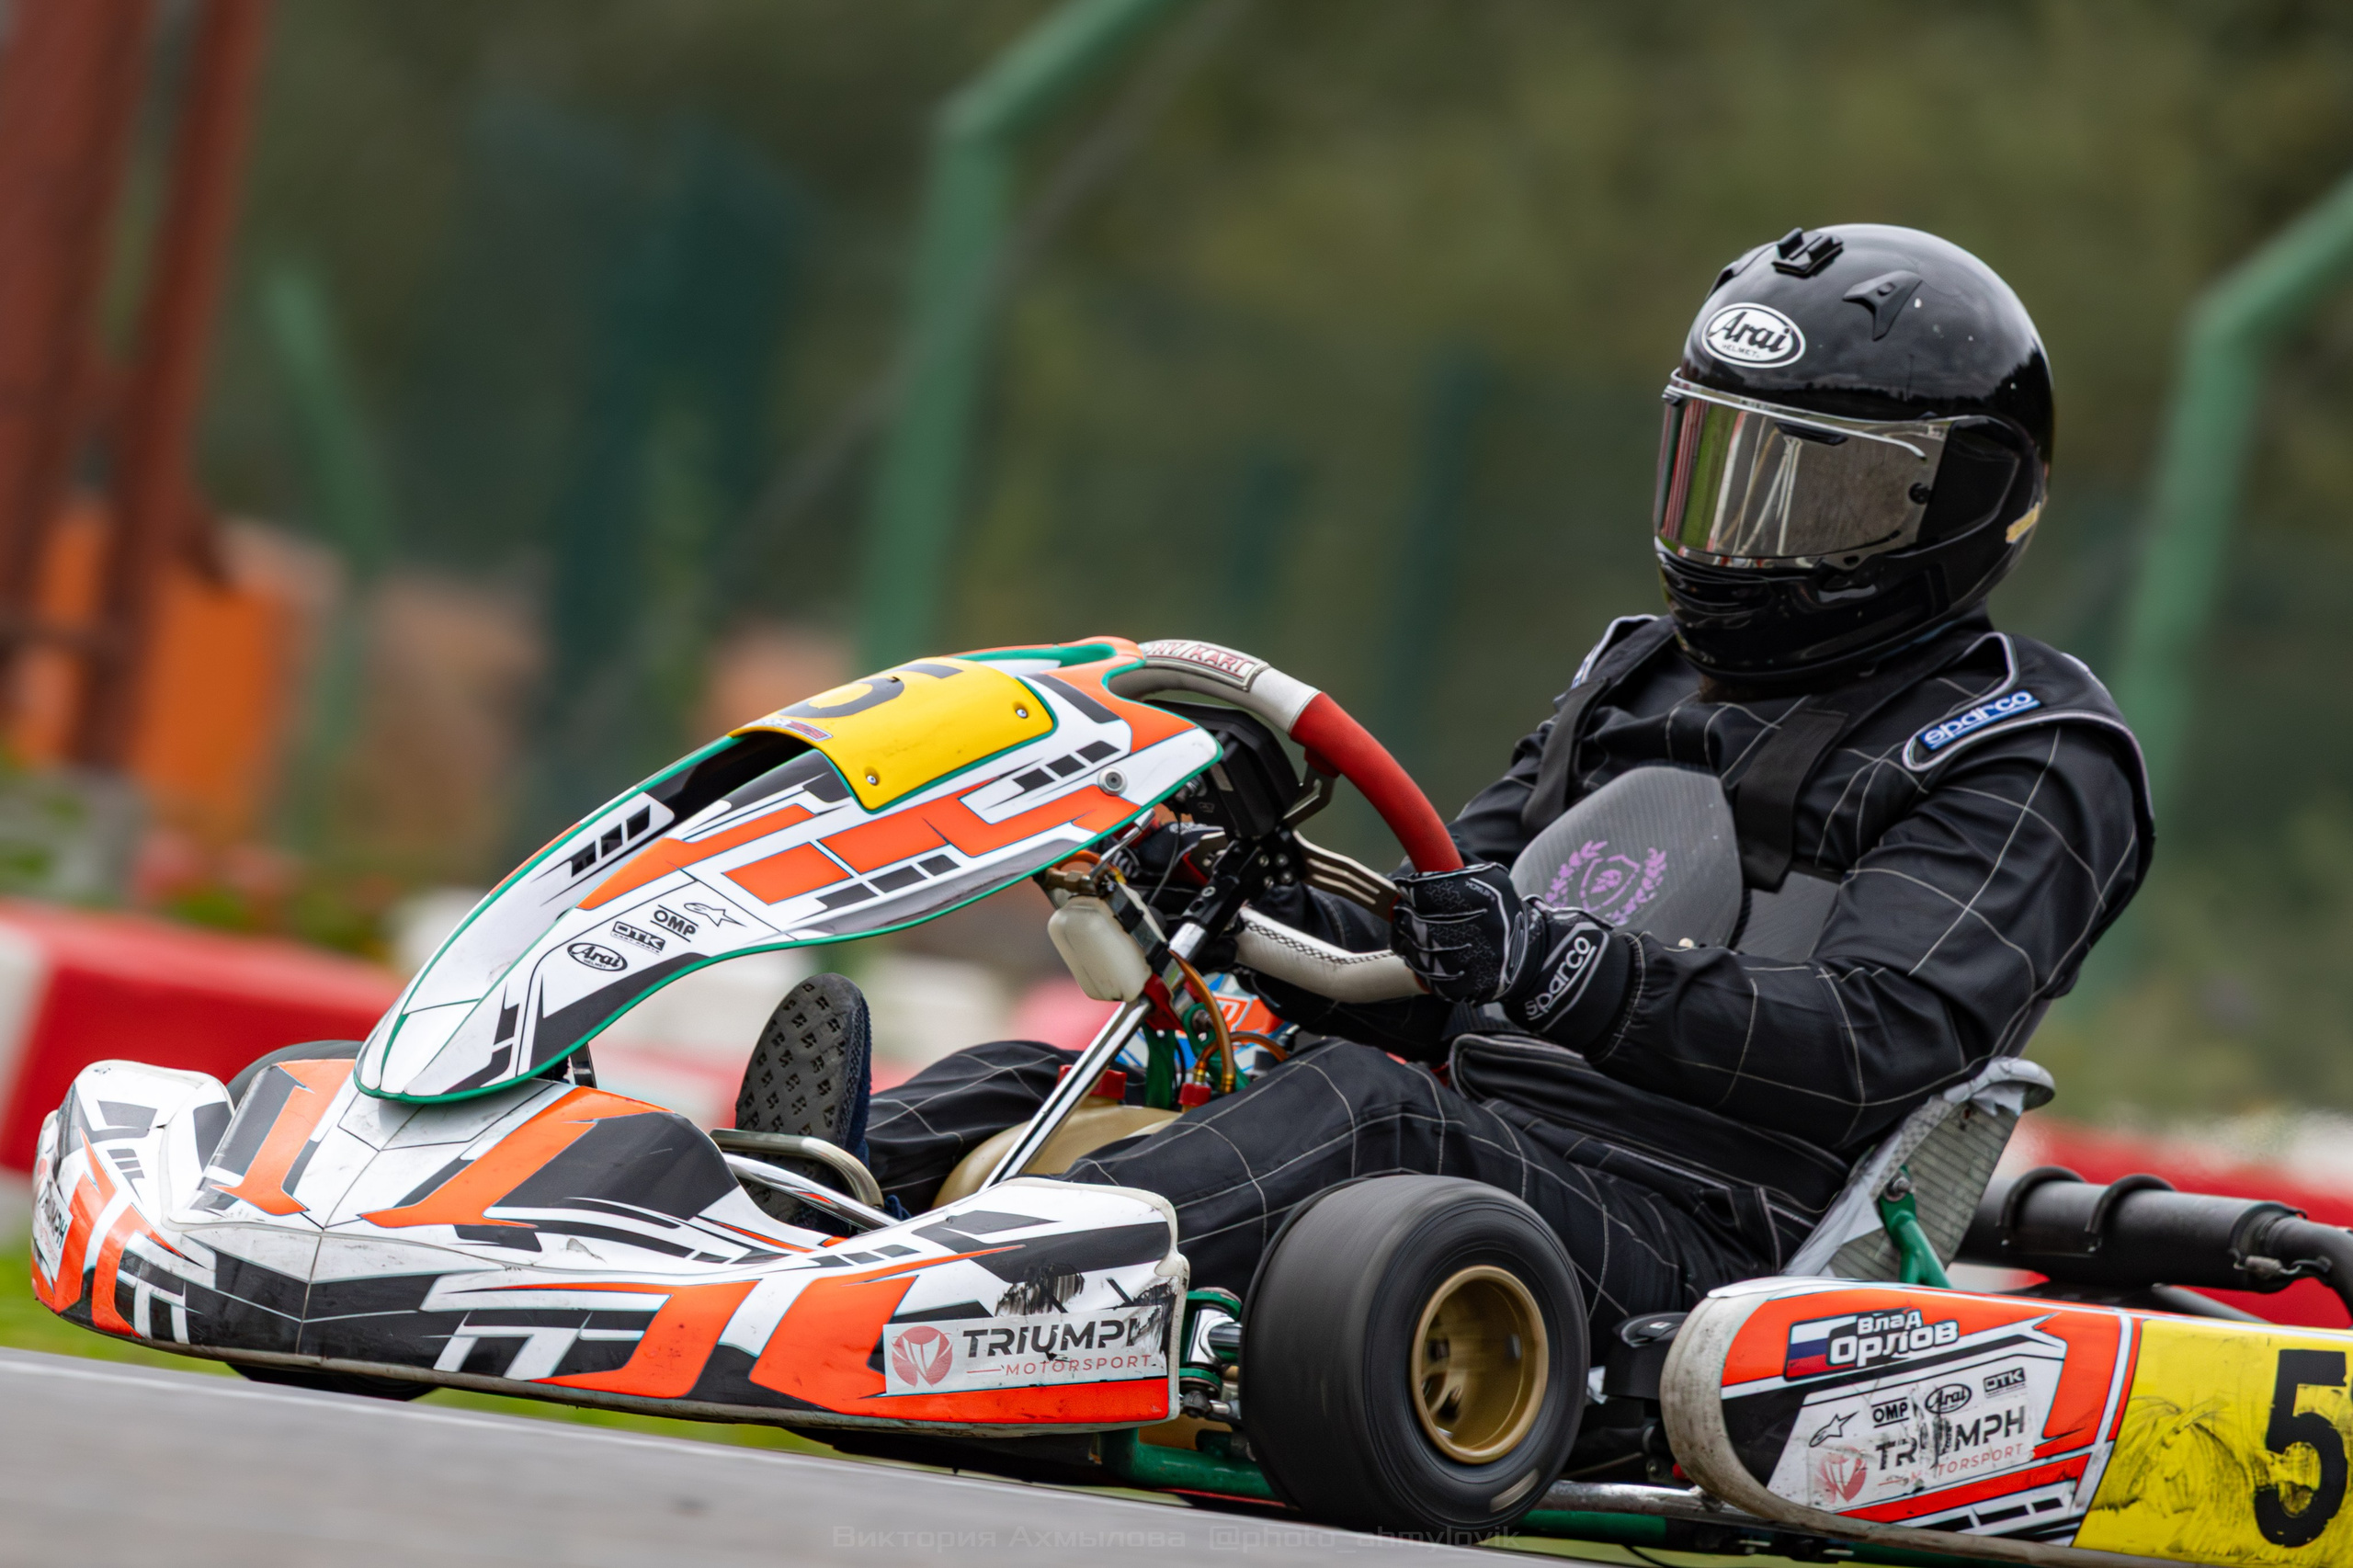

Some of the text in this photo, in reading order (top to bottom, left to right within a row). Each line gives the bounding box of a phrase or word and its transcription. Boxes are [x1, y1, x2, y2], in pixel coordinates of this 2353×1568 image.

[1707, 311, 1790, 353] Arai
[1189, 643, 1256, 673] KART
[1925, 691, 2033, 745] sparco
[613, 922, 665, 949] OTK
[654, 909, 696, 936] OMP
[571, 946, 621, 967] Arai
[1524, 937, 1591, 1017] sparco
[1857, 1310, 1923, 1335] Влад
[1830, 1321, 1960, 1368] Орлов
[1006, 1354, 1152, 1376] MOTORSPORT
[1984, 1369, 2025, 1391] OTK
[1927, 1386, 1966, 1409] Arai
[1872, 1402, 1908, 1423] OMP
[1910, 1443, 2023, 1482] MTORSPORT
